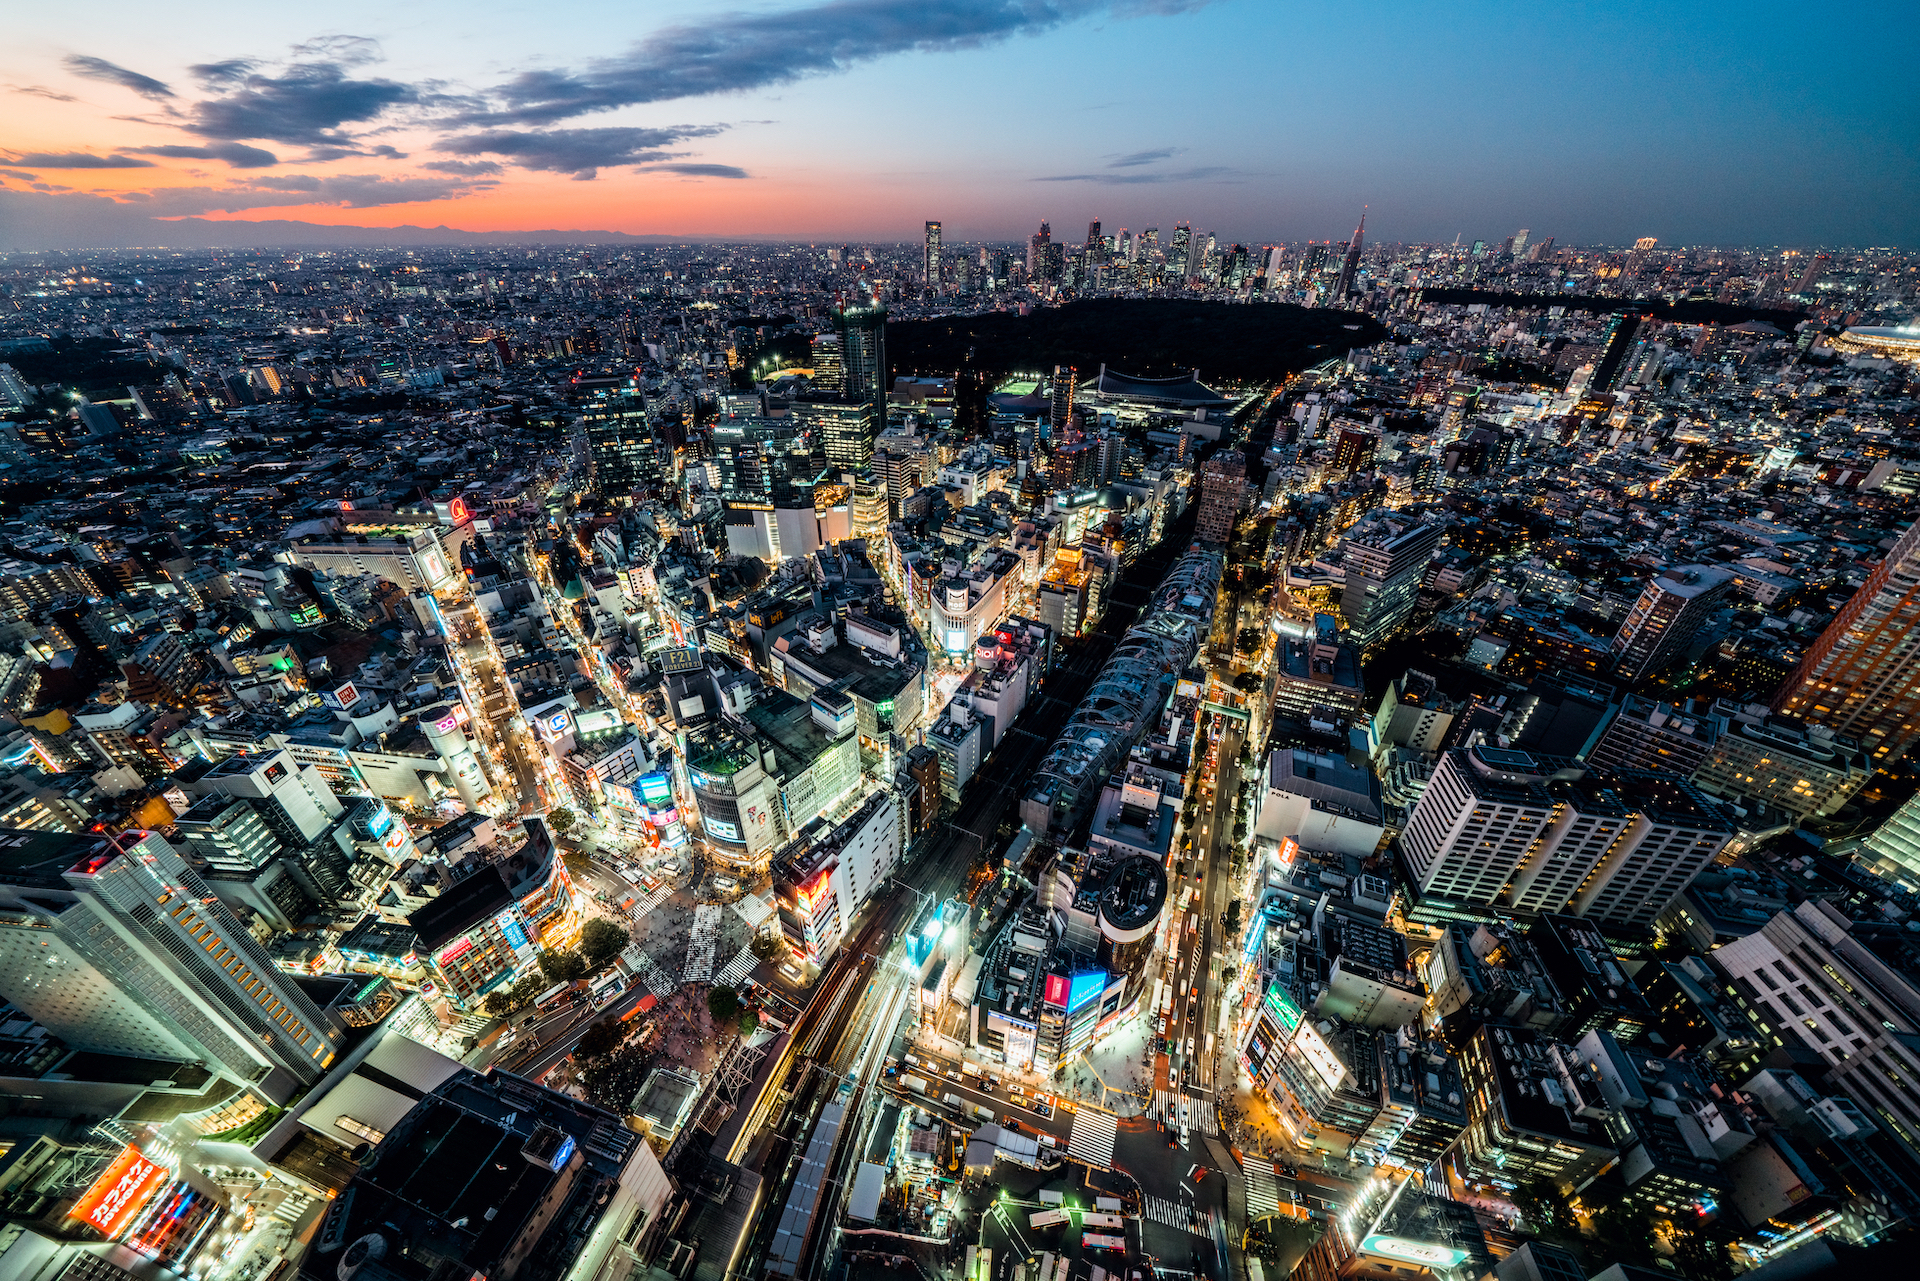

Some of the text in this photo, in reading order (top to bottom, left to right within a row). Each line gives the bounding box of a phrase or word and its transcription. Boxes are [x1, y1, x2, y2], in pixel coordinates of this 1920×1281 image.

[669, 650, 692, 664] F21
[664, 661, 692, 672] FOREVER
[339, 688, 352, 698] UNI
[342, 693, 355, 704] QLO
[435, 717, 457, 732] 109
[1271, 791, 1290, 800] POLA
[769, 793, 784, 837] TSUTAYA
[90, 1159, 143, 1223] カラオケ
[100, 1164, 154, 1228] JOYSOUND
